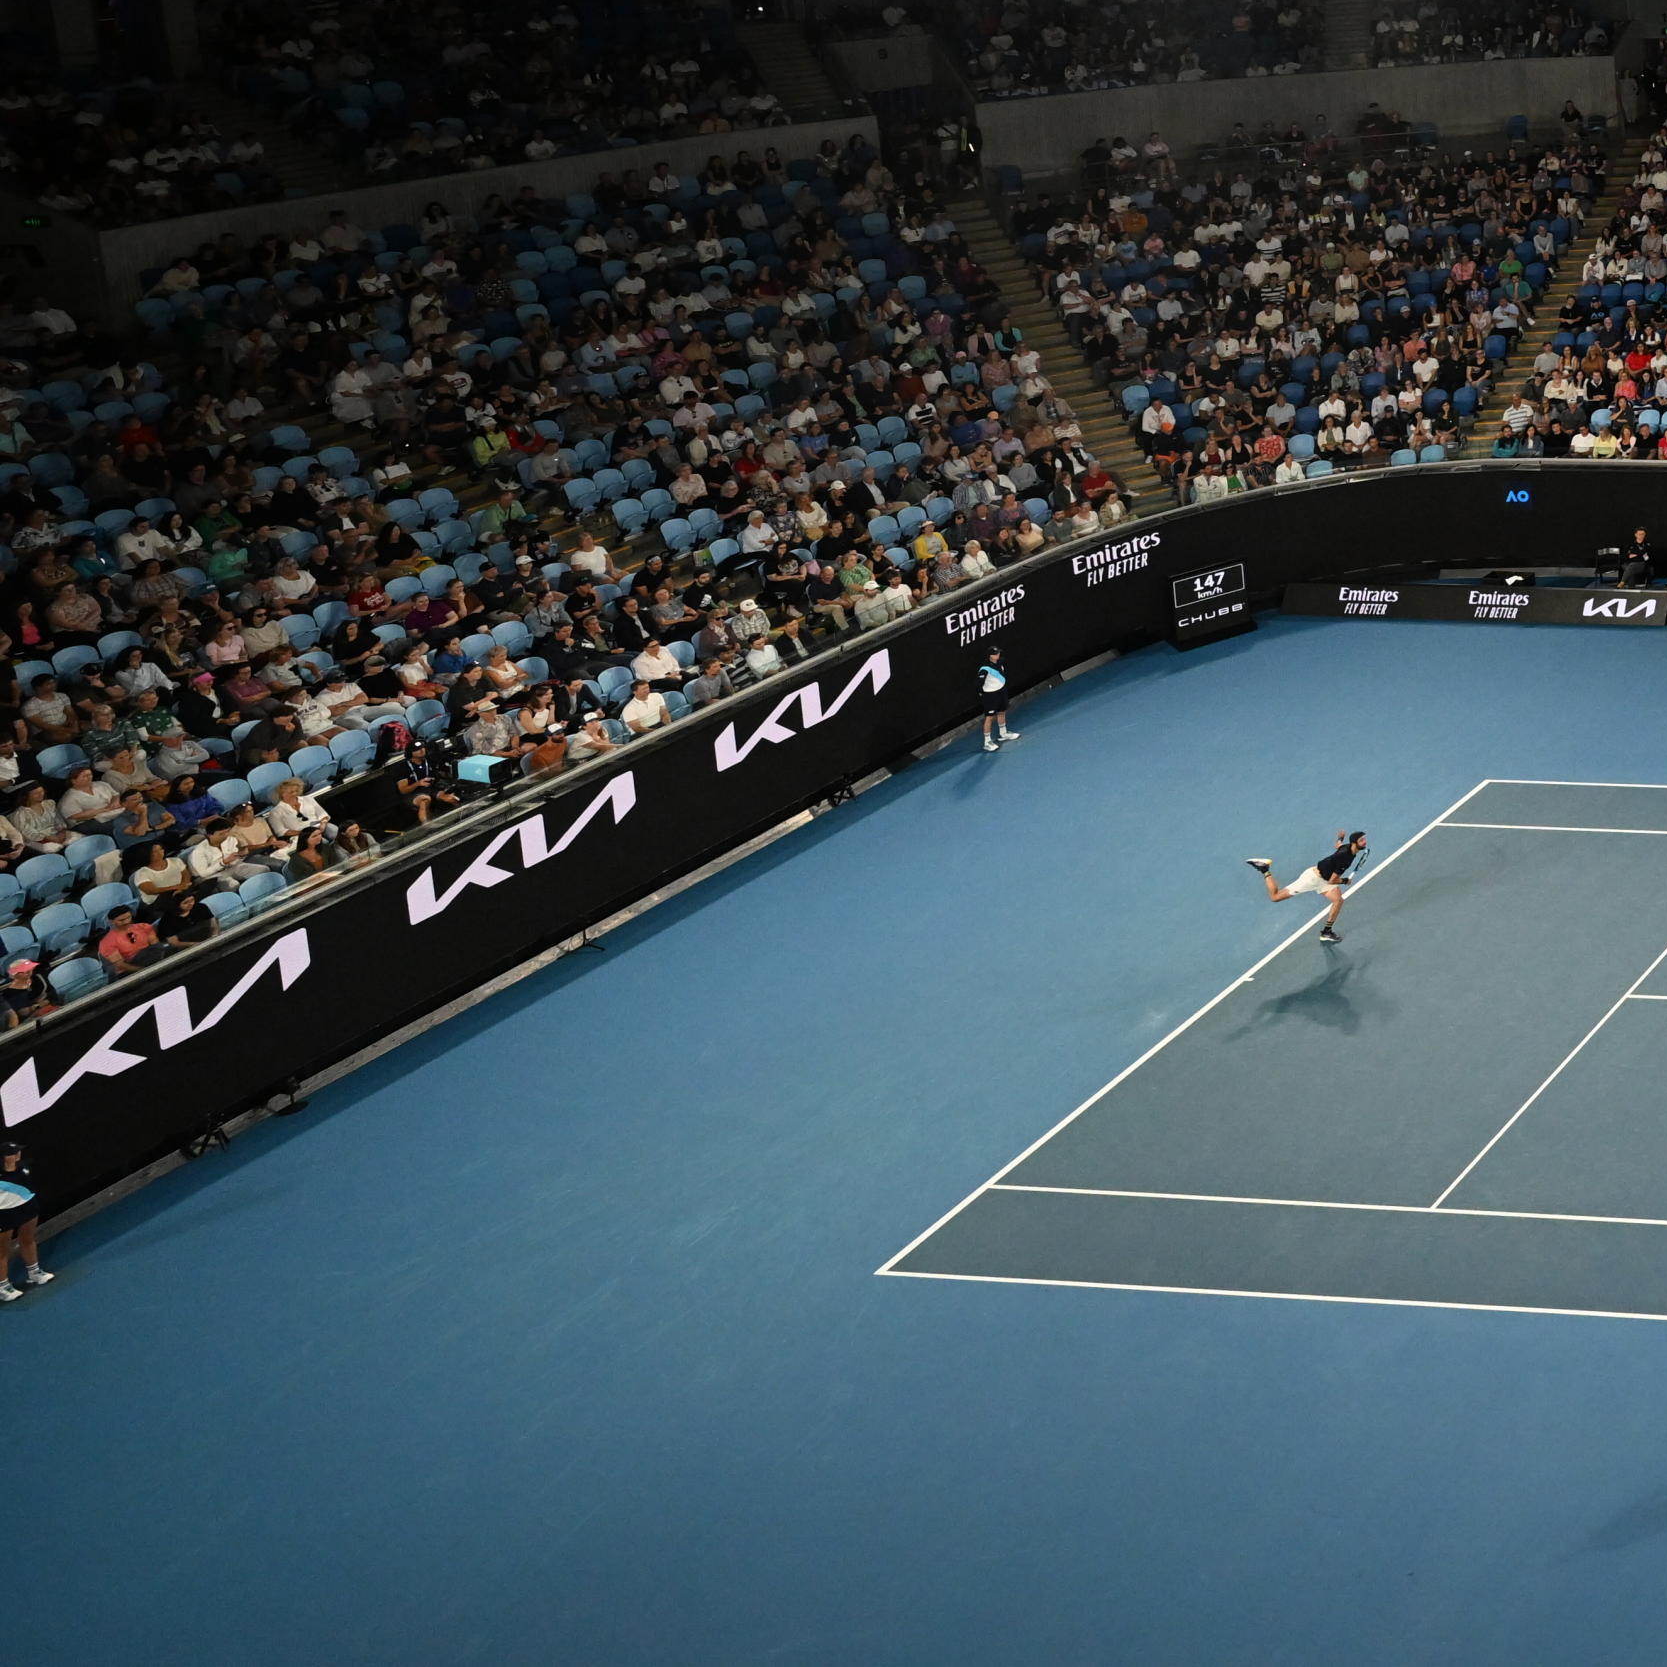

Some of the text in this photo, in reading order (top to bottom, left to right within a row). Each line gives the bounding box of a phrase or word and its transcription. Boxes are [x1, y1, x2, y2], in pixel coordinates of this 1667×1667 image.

[1506, 490, 1530, 503] AO
[1072, 532, 1161, 575] Emirates
[1087, 552, 1149, 588] FLY BETTER
[1193, 571, 1225, 591] 147
[1197, 586, 1223, 599] km/h
[1338, 587, 1399, 602] Emirates
[1468, 591, 1530, 606] Emirates
[945, 584, 1026, 634] Emirates
[1344, 603, 1388, 615] FLY BETTER
[1474, 606, 1519, 619] FLY BETTER
[1583, 598, 1657, 618] KIA
[960, 606, 1016, 647] FLY BETTER
[714, 649, 892, 772] KIA
[407, 770, 637, 925] KIA
[0, 928, 311, 1127] KIA
